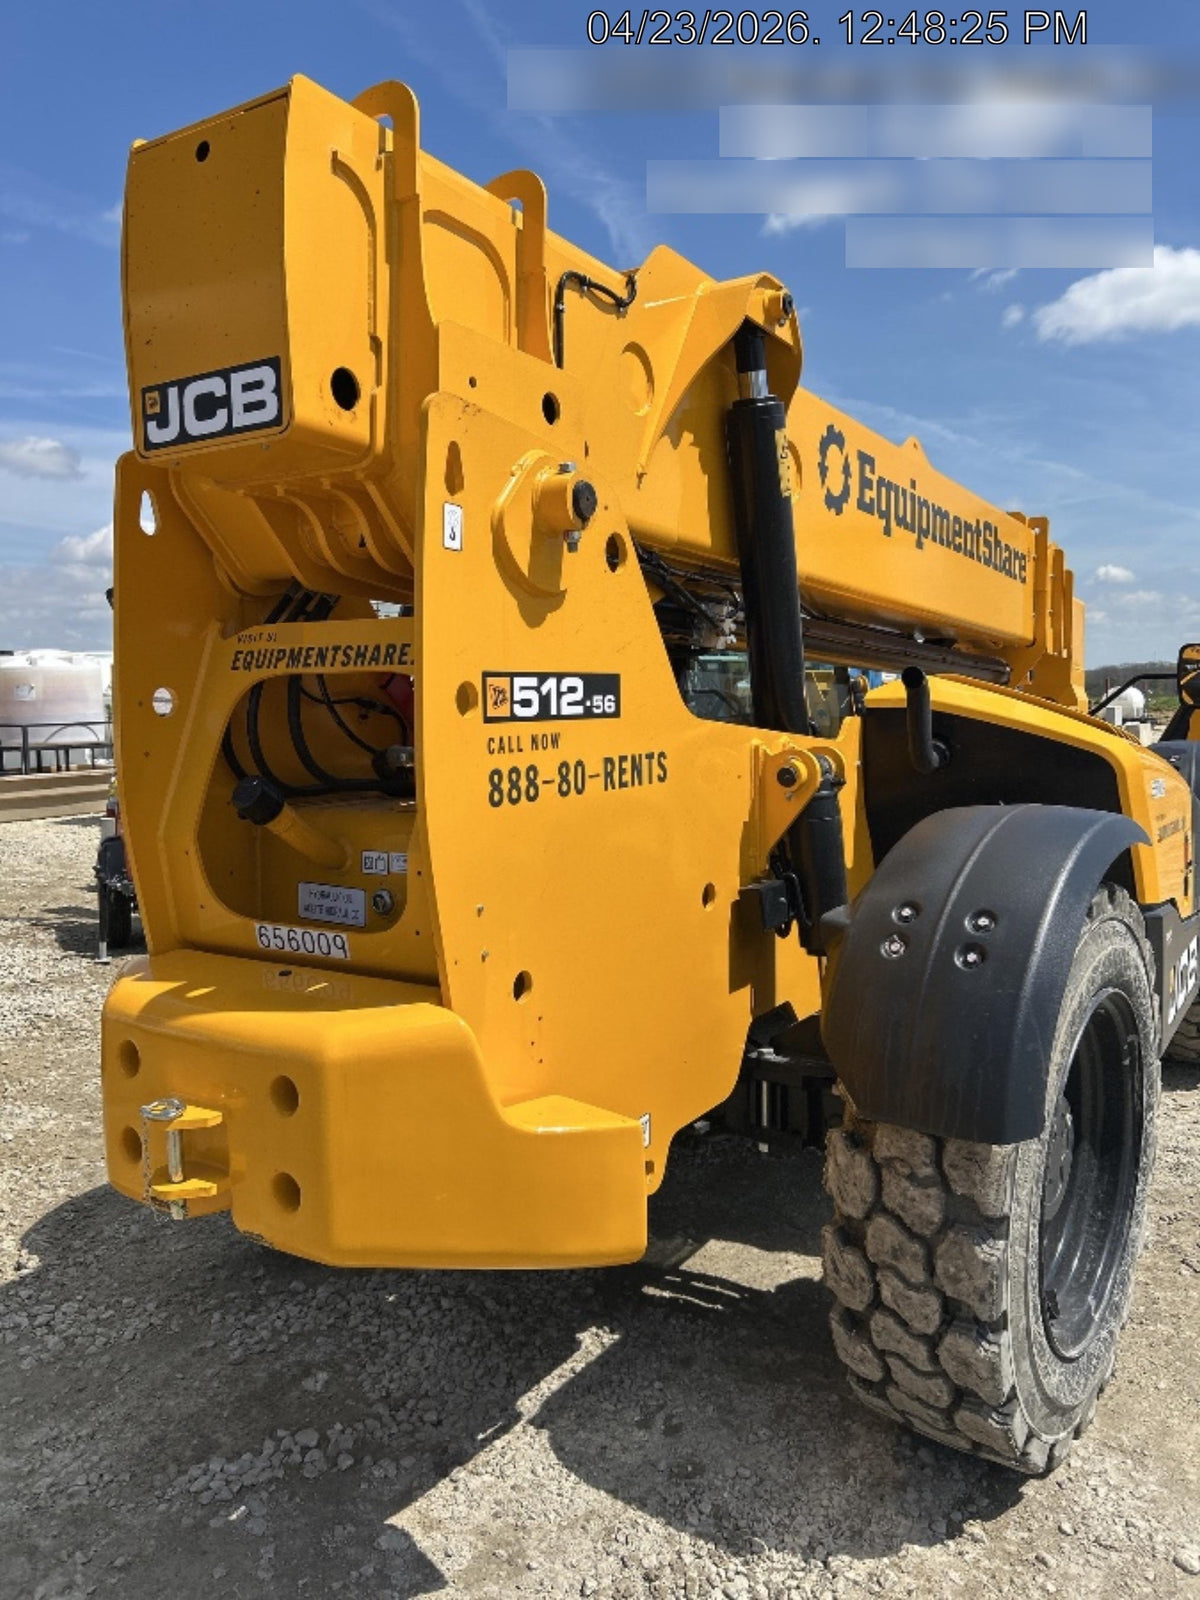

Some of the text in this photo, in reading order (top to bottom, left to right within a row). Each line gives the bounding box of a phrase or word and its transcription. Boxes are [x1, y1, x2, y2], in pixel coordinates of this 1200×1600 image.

[146, 365, 279, 444] JCB
[856, 449, 1027, 584] EquipmentShare
[487, 731, 561, 755] CALL NOW
[488, 751, 668, 808] 888-80-RENTS
[258, 925, 348, 959] 656009
